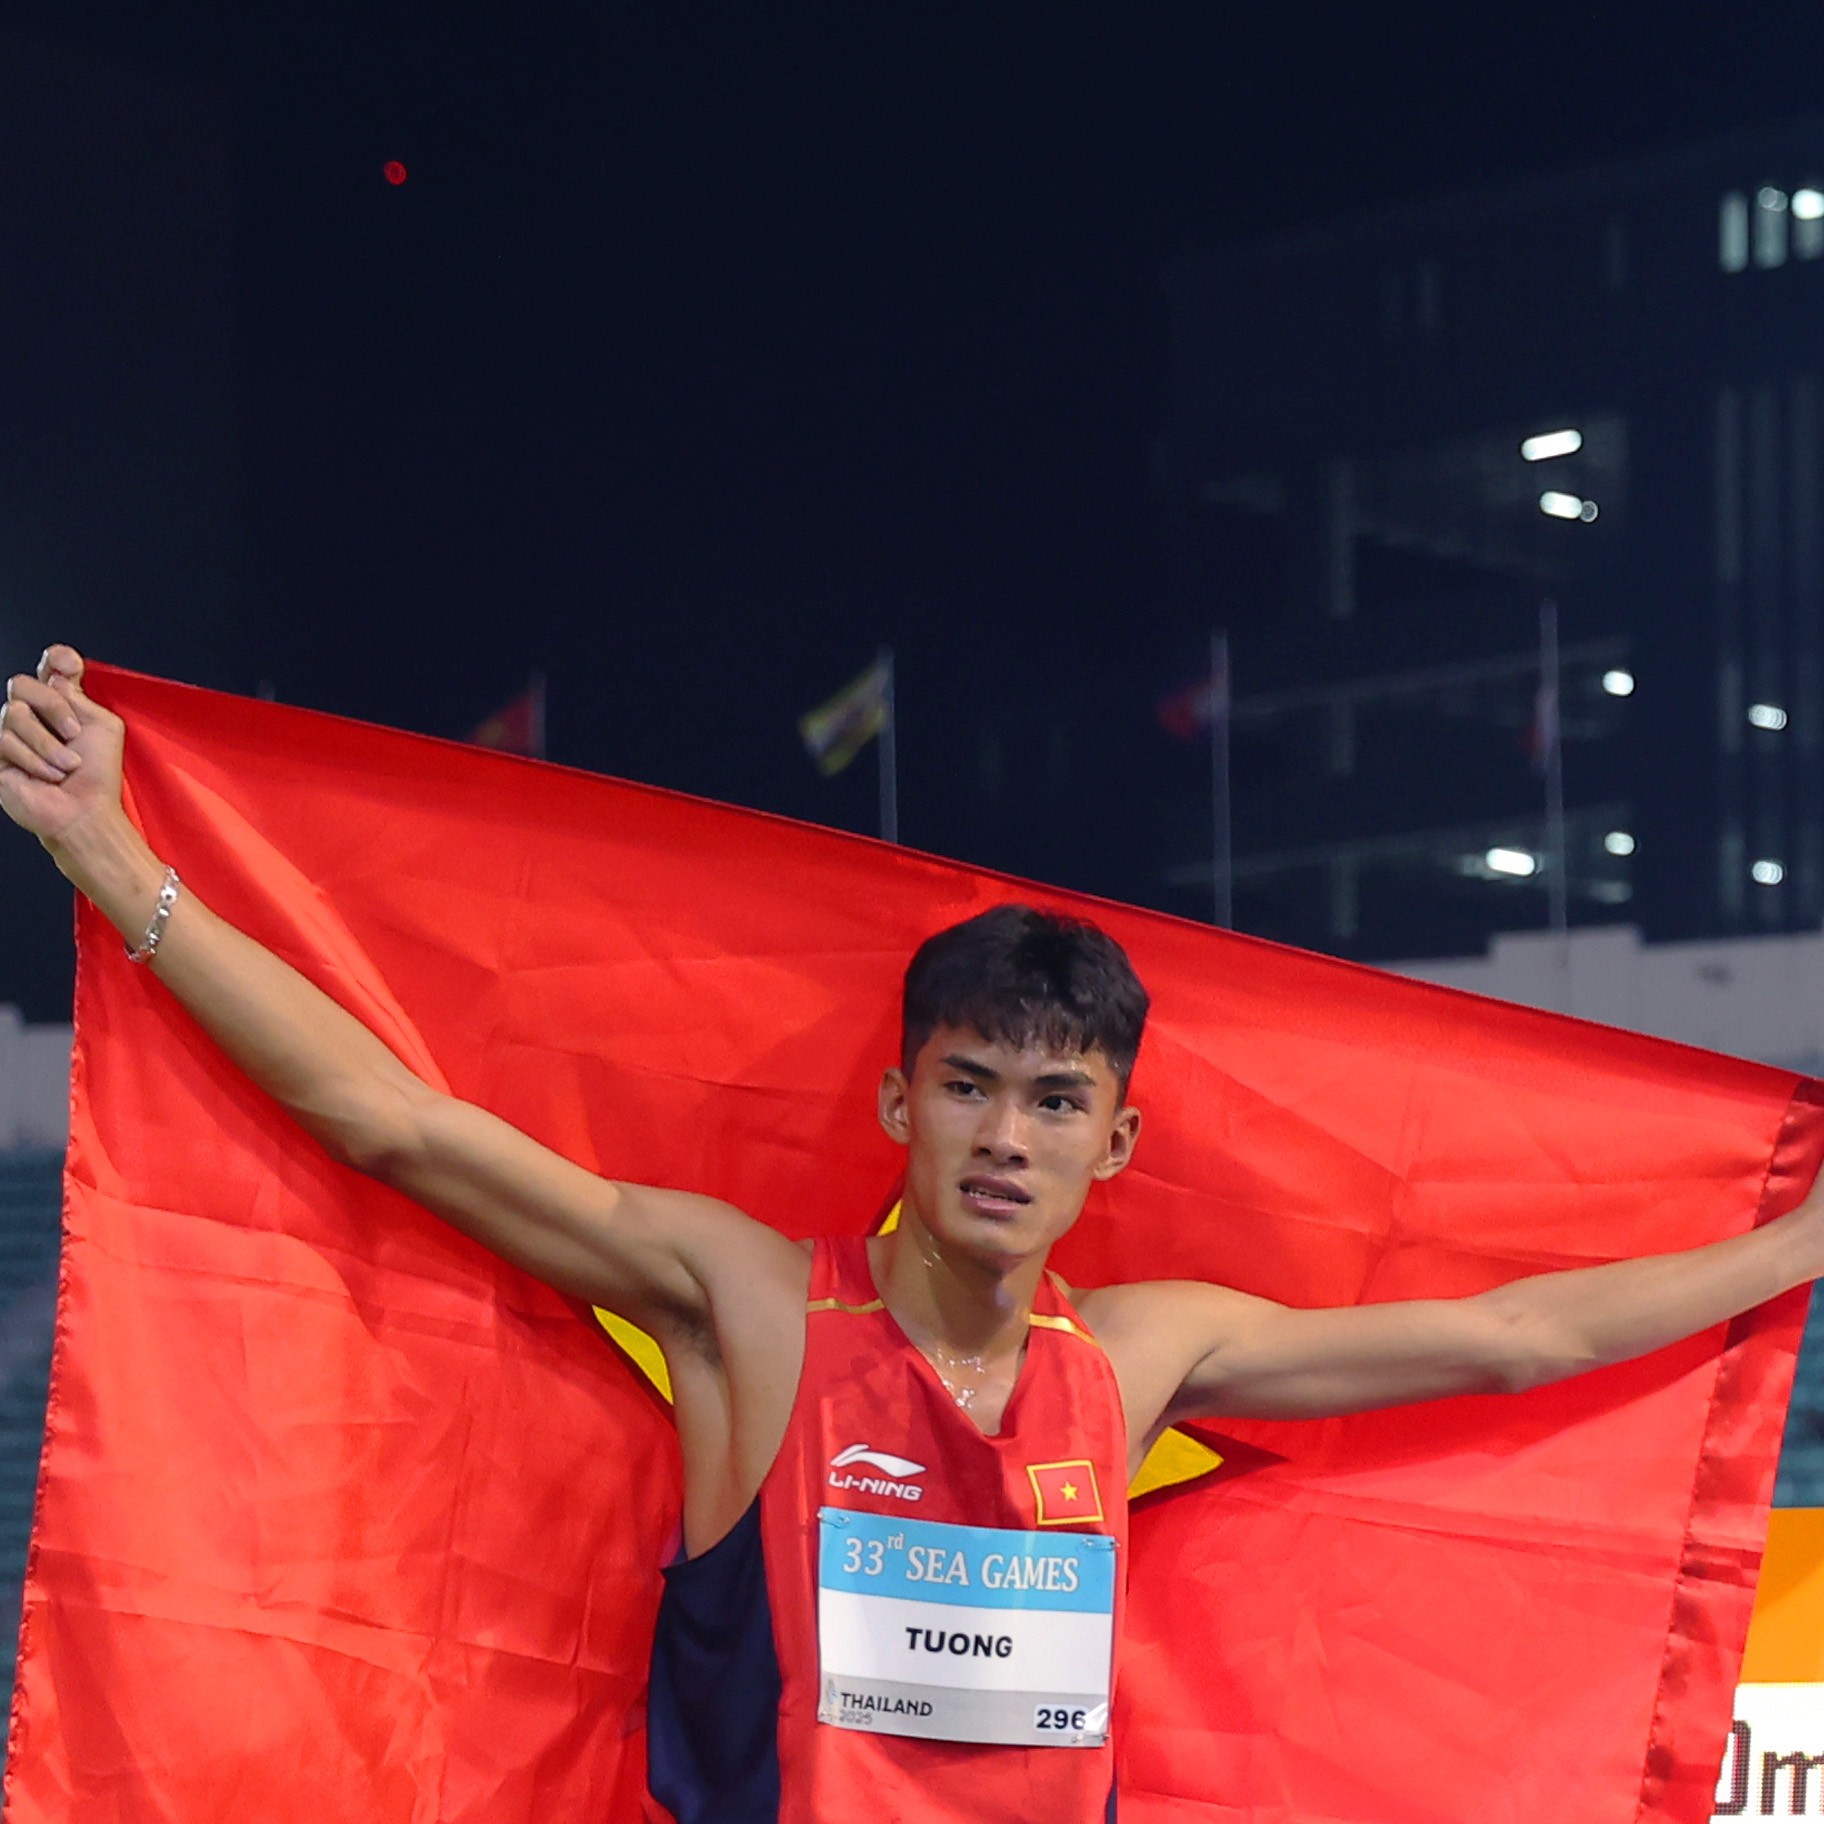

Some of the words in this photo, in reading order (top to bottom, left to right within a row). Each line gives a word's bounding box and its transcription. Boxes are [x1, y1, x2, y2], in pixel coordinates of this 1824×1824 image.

[828, 1471, 923, 1501] LI-NING
[842, 1532, 905, 1577] 33rd
[905, 1546, 970, 1587] SEA
[981, 1553, 1080, 1593] GAMES
[905, 1627, 1013, 1659] TUONG
[840, 1693, 933, 1717] THAILAND
[1036, 1708, 1087, 1731] 296
